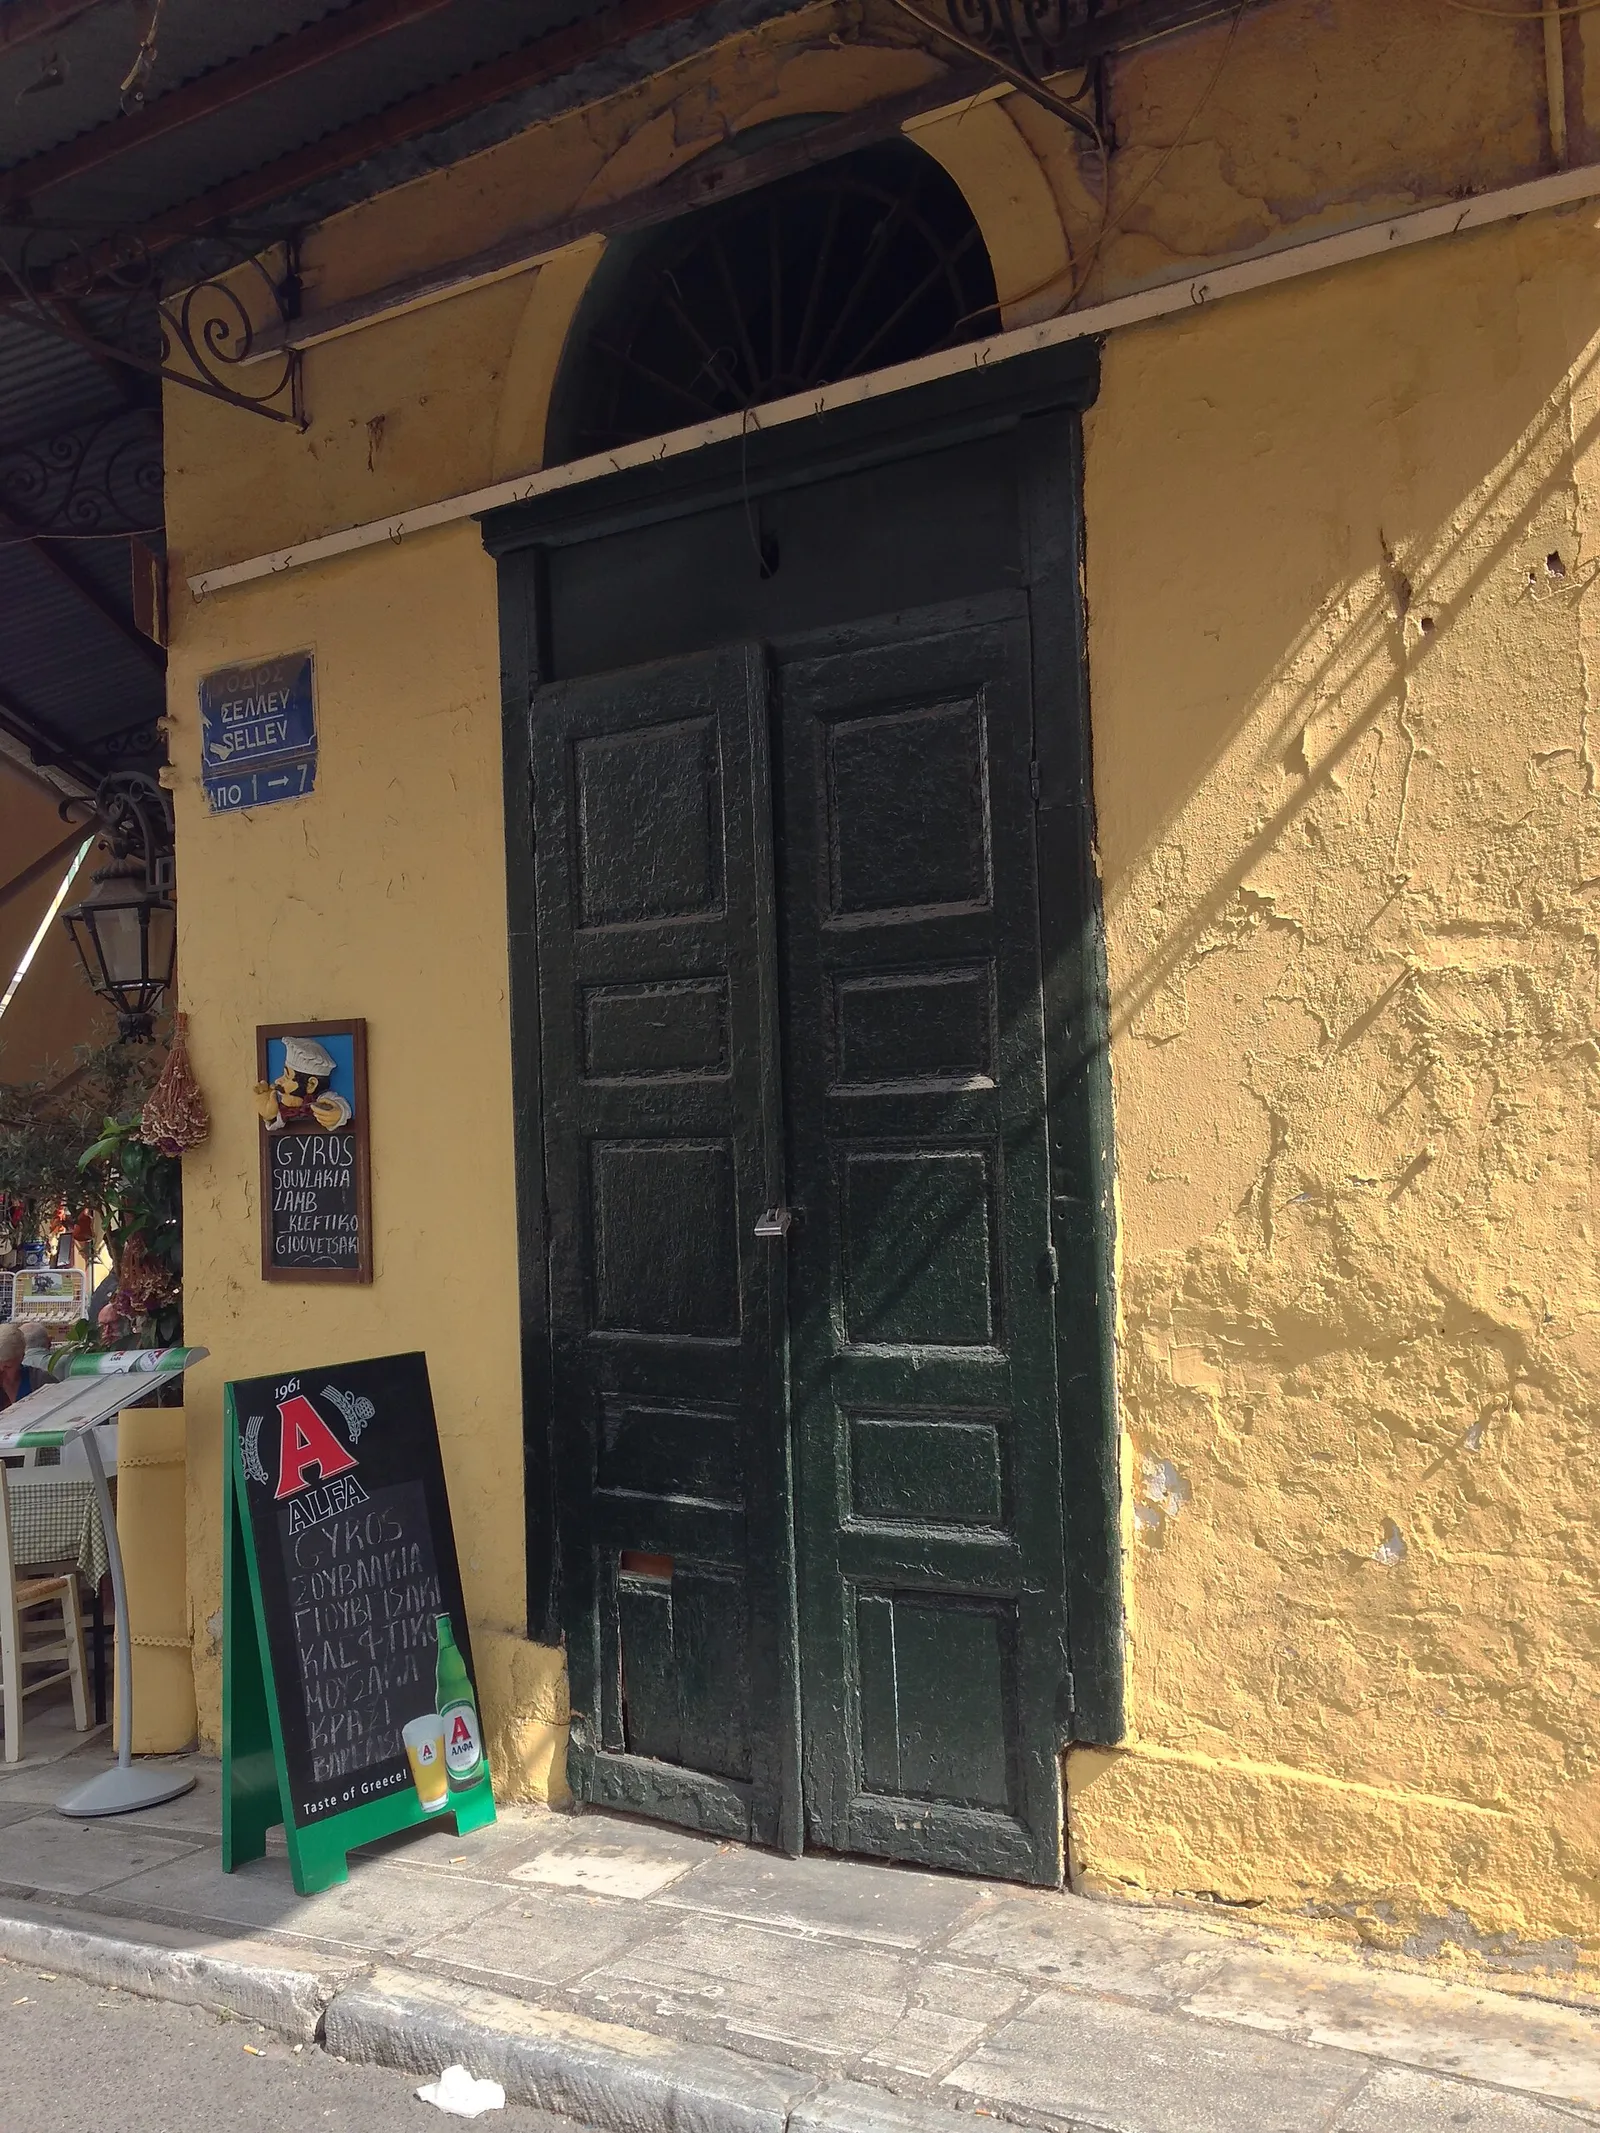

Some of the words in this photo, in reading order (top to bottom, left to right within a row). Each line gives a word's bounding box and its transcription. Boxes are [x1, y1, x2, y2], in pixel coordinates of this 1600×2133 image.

[227, 665, 284, 692] ΟΔΟΣ
[223, 720, 287, 751] SELLEV
[252, 774, 258, 801] 1
[297, 763, 308, 792] 7
[277, 1135, 354, 1166] GYROS
[273, 1169, 350, 1190] SOUVLAKIA
[274, 1190, 318, 1213] LAMB
[275, 1235, 360, 1254] GIOUVETSAKI
[275, 1377, 301, 1400] 1961
[274, 1395, 359, 1500] A
[288, 1474, 370, 1536] ALFA
[451, 1741, 474, 1756] ΑΛΦΑ
[303, 1796, 337, 1815] Taste
[342, 1786, 355, 1801] of
[360, 1768, 407, 1794] Greece!
